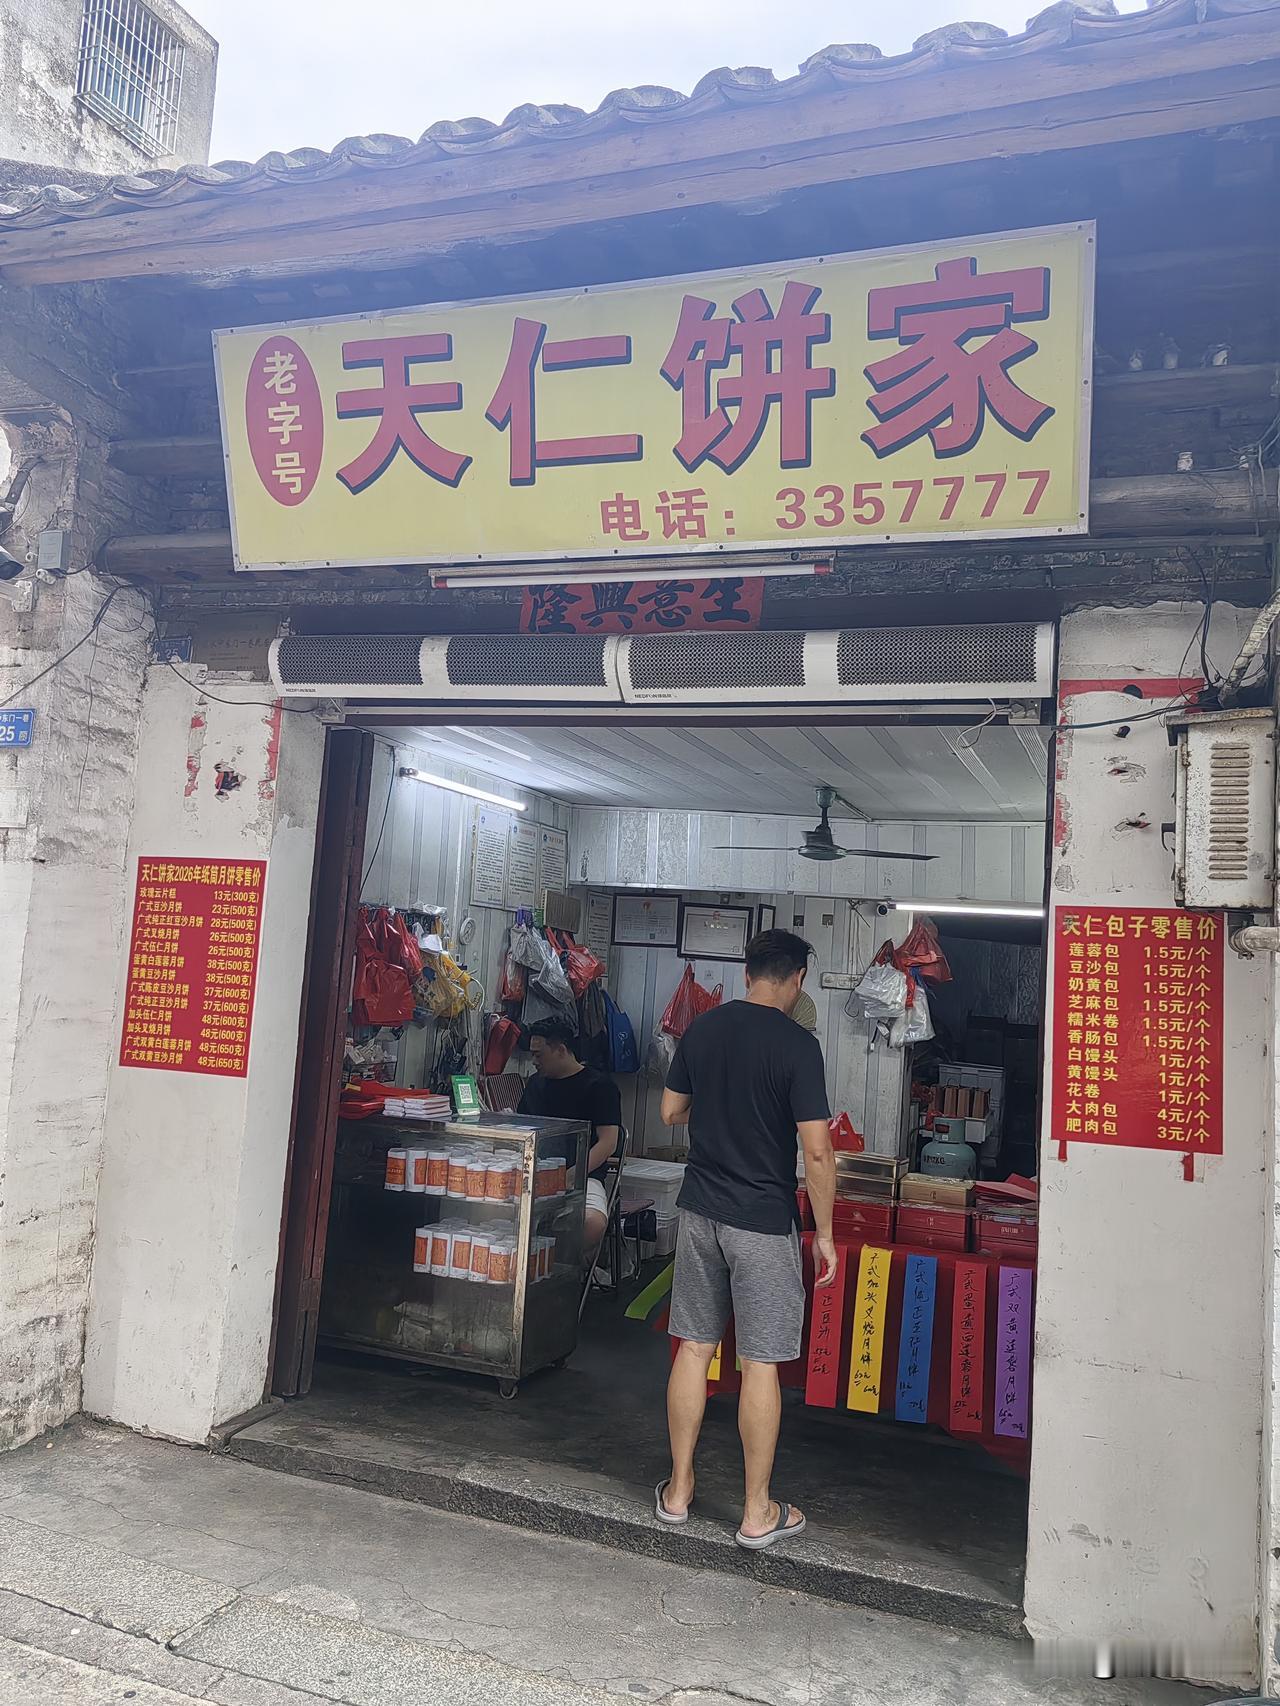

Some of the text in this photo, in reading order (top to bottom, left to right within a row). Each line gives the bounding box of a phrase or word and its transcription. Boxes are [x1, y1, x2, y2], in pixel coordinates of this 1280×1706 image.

[335, 257, 1055, 496] 天仁饼家
[262, 349, 307, 496] 老字号
[138, 902, 182, 912] 广式豆沙月饼
[136, 928, 180, 940] 广式叉烧月饼
[1062, 915, 1217, 941] 天仁包子零售价
[135, 942, 179, 953] 广式伍仁月饼
[1068, 943, 1211, 961] 莲蓉包 1.5元/个
[1069, 961, 1211, 979] 豆沙包 1.5元/个
[1068, 978, 1211, 997] 奶黄包 1.5元/个
[1068, 995, 1211, 1015] 芝麻包 1.5元/个
[1068, 1012, 1211, 1033] 糯米卷 1.5元/个
[1067, 1030, 1211, 1051] 香肠包 1.5元/个
[1067, 1048, 1211, 1070] 白馒头 1元/个
[1067, 1065, 1210, 1088] 黄馒头 1元/个
[1067, 1083, 1210, 1106] 花卷 1元/个
[1066, 1100, 1210, 1125] 大肉包 4元/个
[1066, 1118, 1210, 1143] 肥肉包 3元/个
